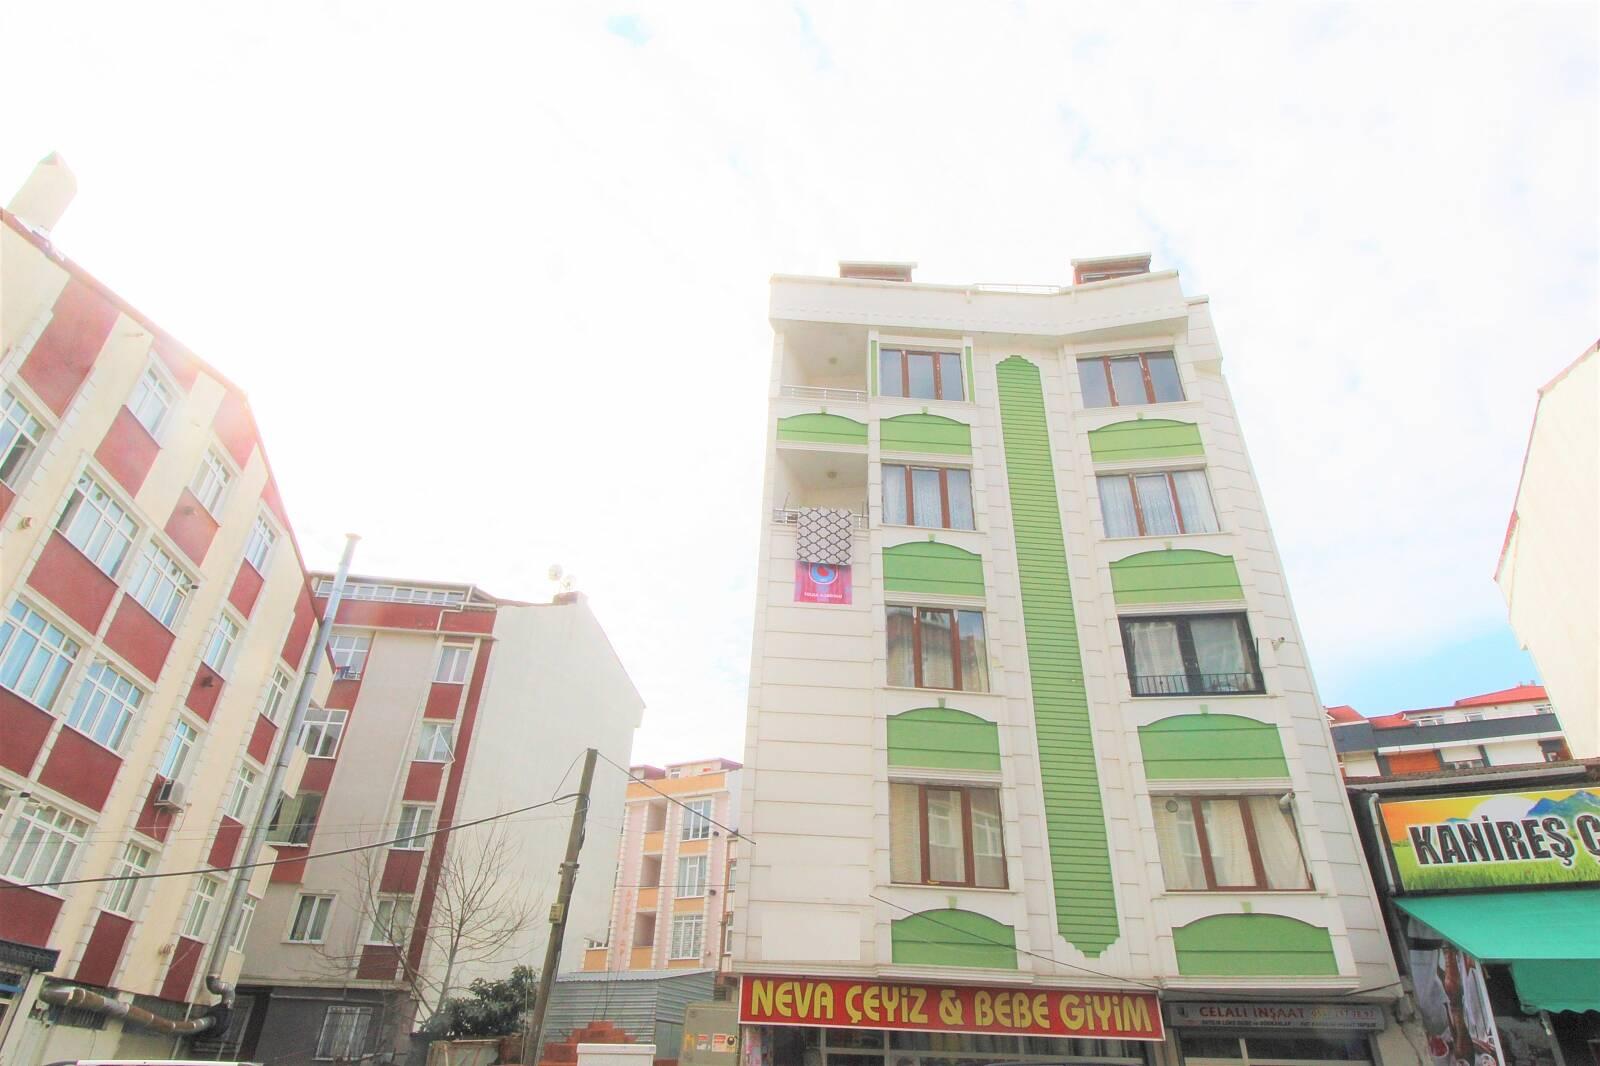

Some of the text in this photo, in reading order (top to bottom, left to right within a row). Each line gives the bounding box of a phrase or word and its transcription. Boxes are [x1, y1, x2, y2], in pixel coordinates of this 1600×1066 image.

[751, 979, 834, 1019] NEVA
[939, 990, 965, 1026] &
[974, 990, 1050, 1029] BEBE
